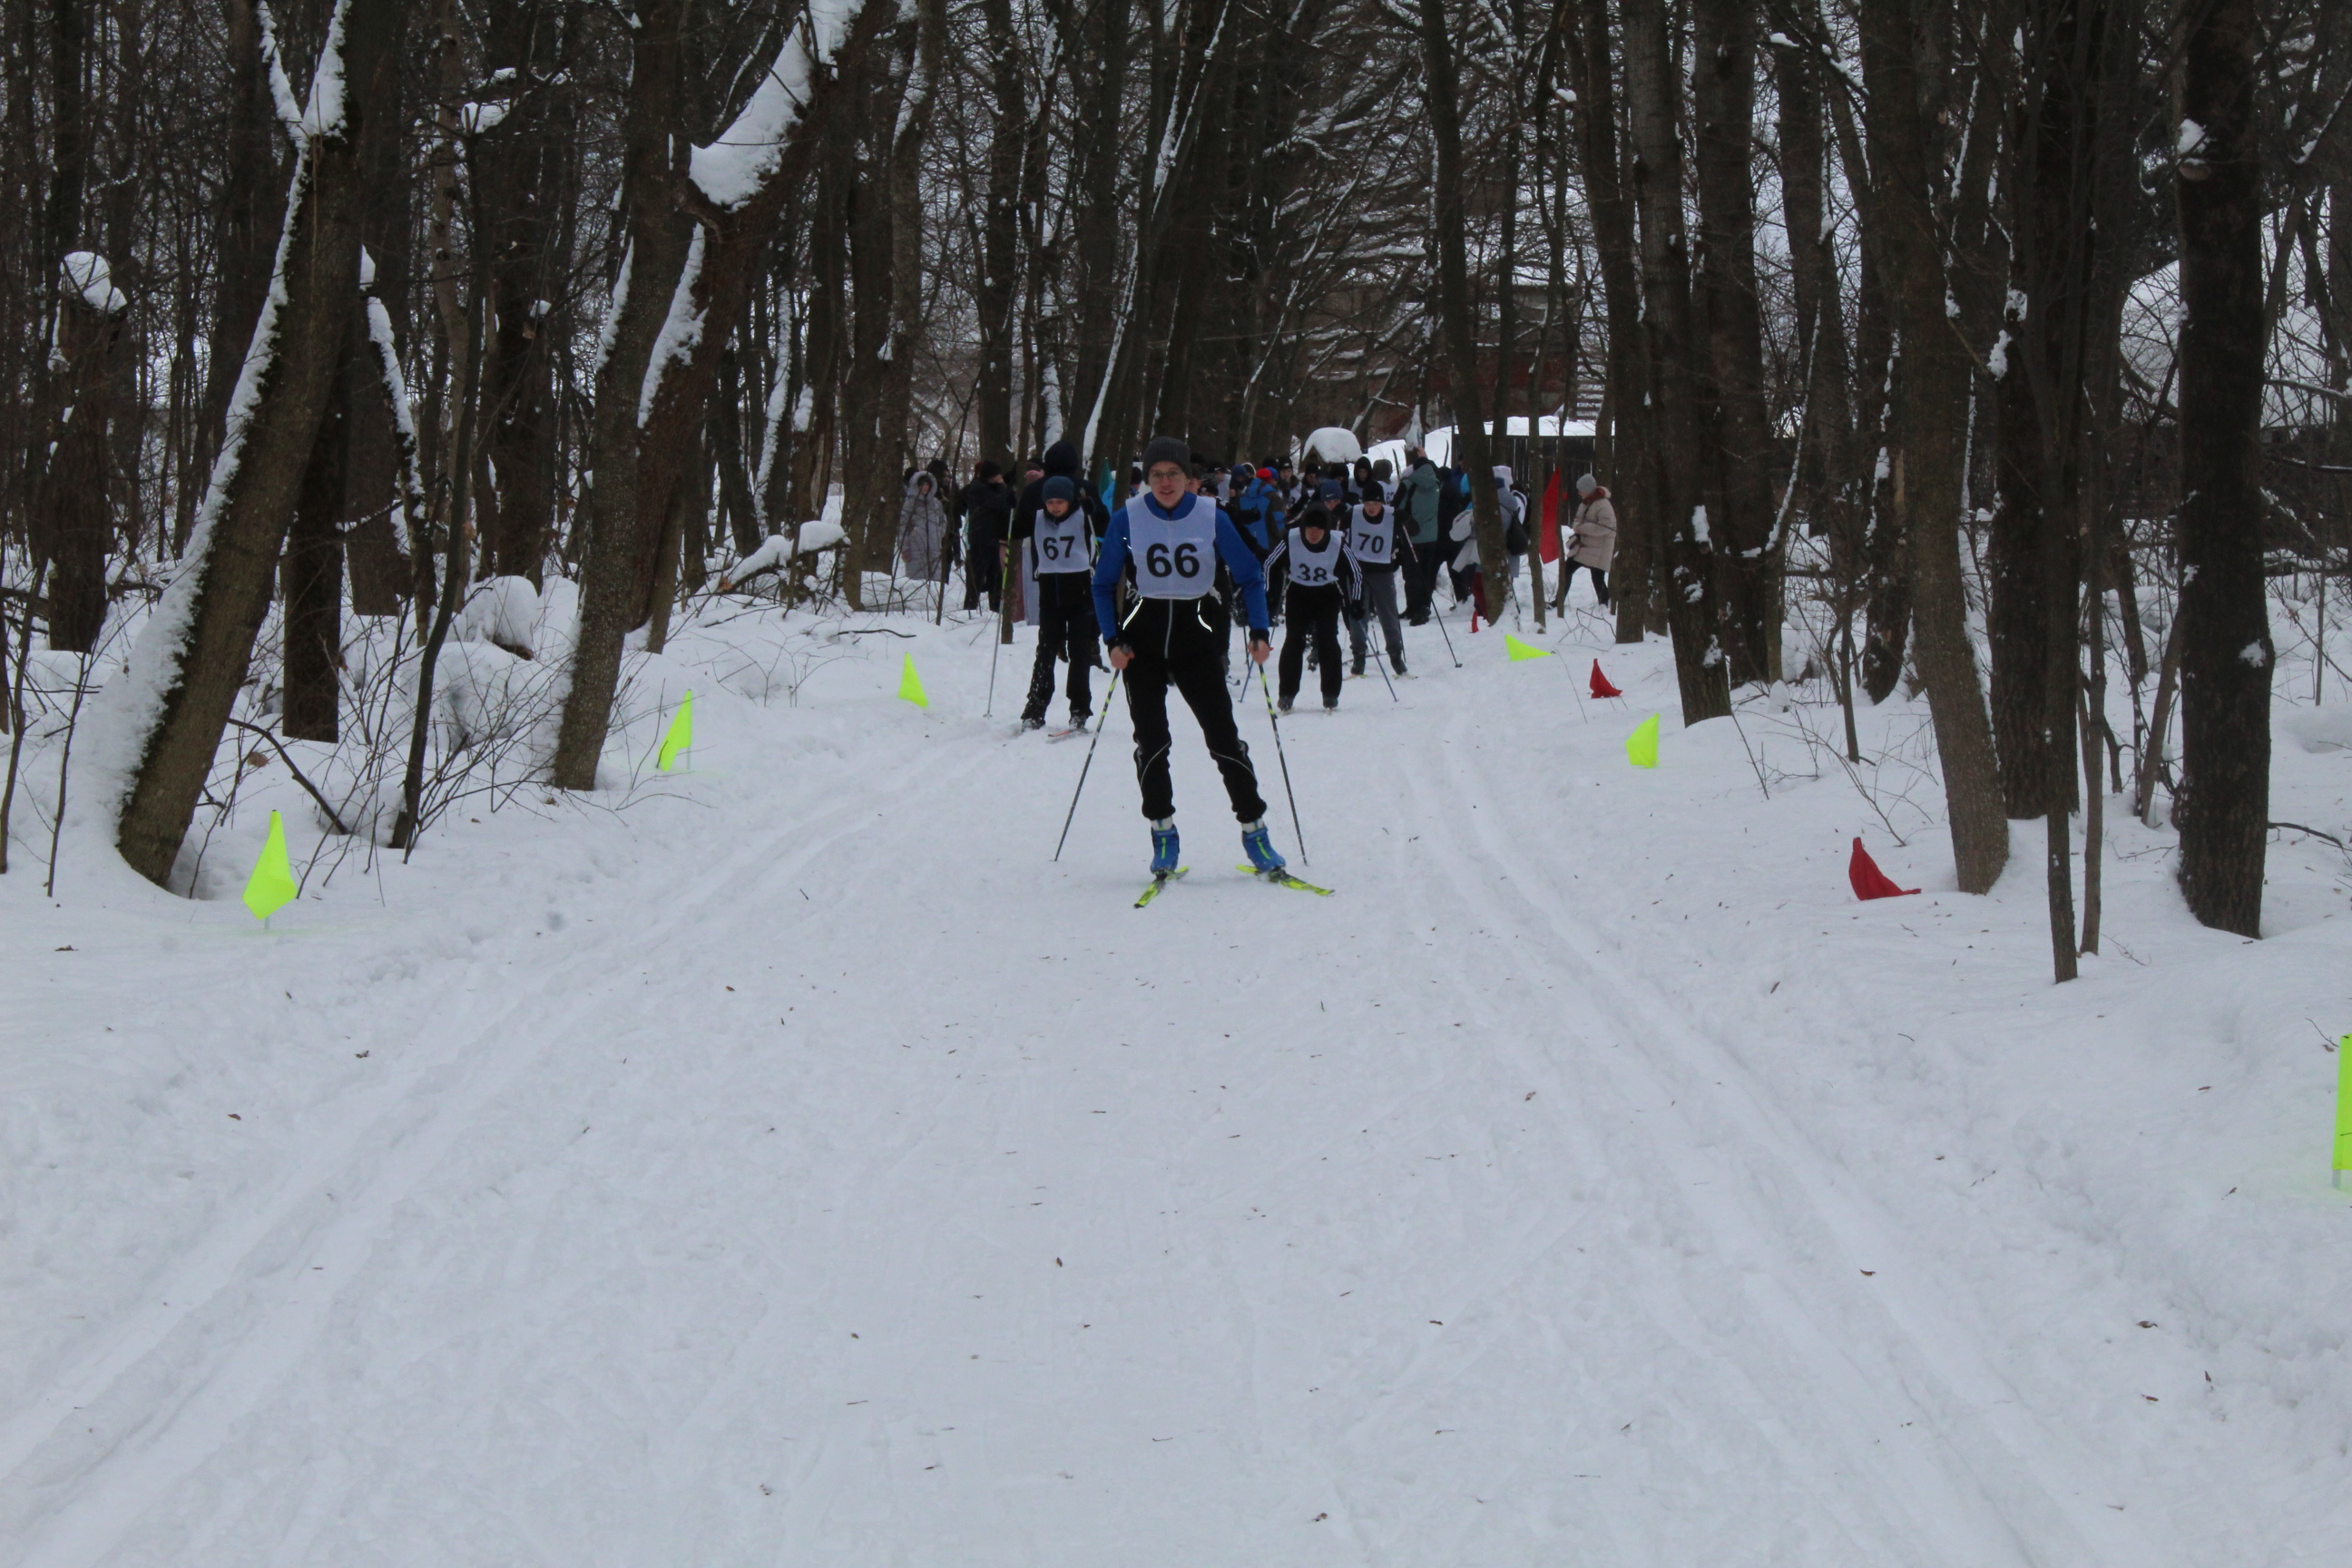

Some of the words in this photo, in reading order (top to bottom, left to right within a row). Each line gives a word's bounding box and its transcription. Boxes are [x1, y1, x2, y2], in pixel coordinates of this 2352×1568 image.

[1043, 535, 1074, 561] 67
[1357, 533, 1385, 554] 70
[1146, 543, 1200, 578] 66
[1297, 563, 1328, 582] 38
